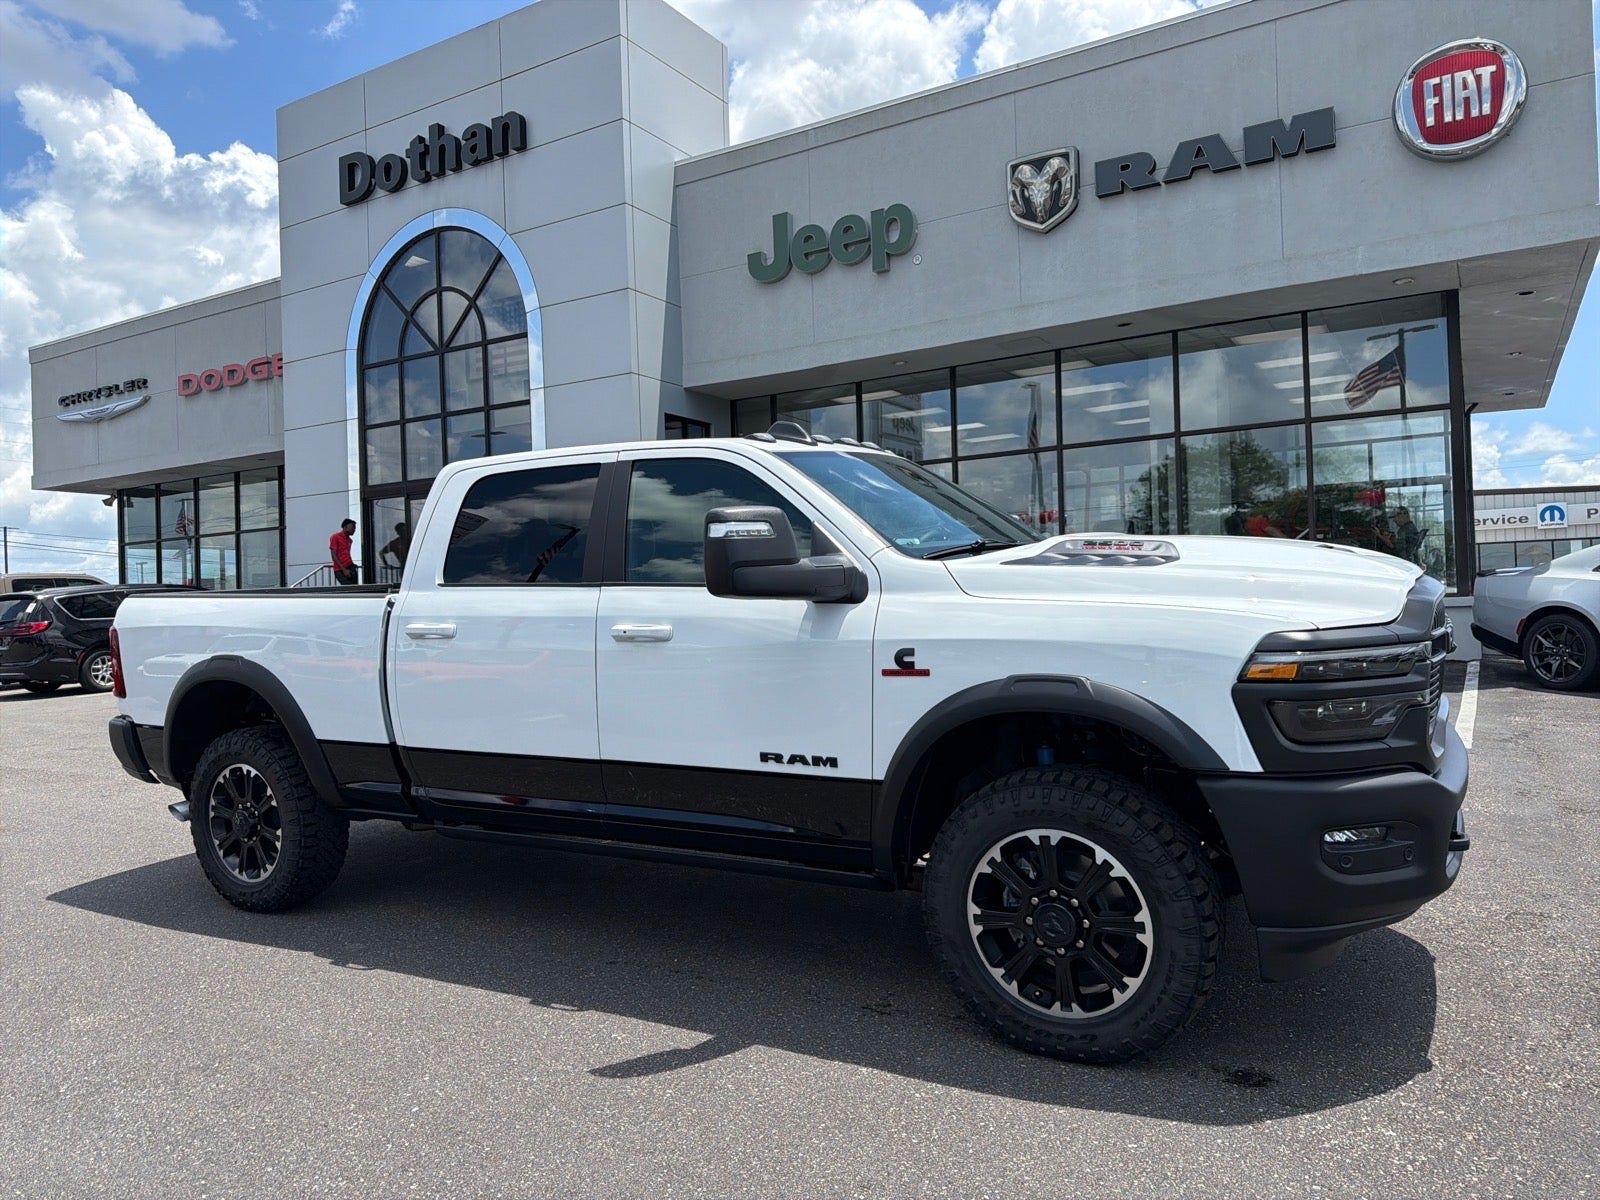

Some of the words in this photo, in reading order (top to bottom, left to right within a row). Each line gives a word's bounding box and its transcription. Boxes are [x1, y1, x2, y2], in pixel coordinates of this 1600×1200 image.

[1423, 65, 1497, 128] FIAT
[338, 110, 527, 206] Dothan
[1095, 106, 1336, 199] RAM
[747, 203, 918, 284] Jeep
[58, 377, 149, 407] CHRYSLER
[1586, 507, 1600, 519] P
[760, 751, 838, 768] RAM
